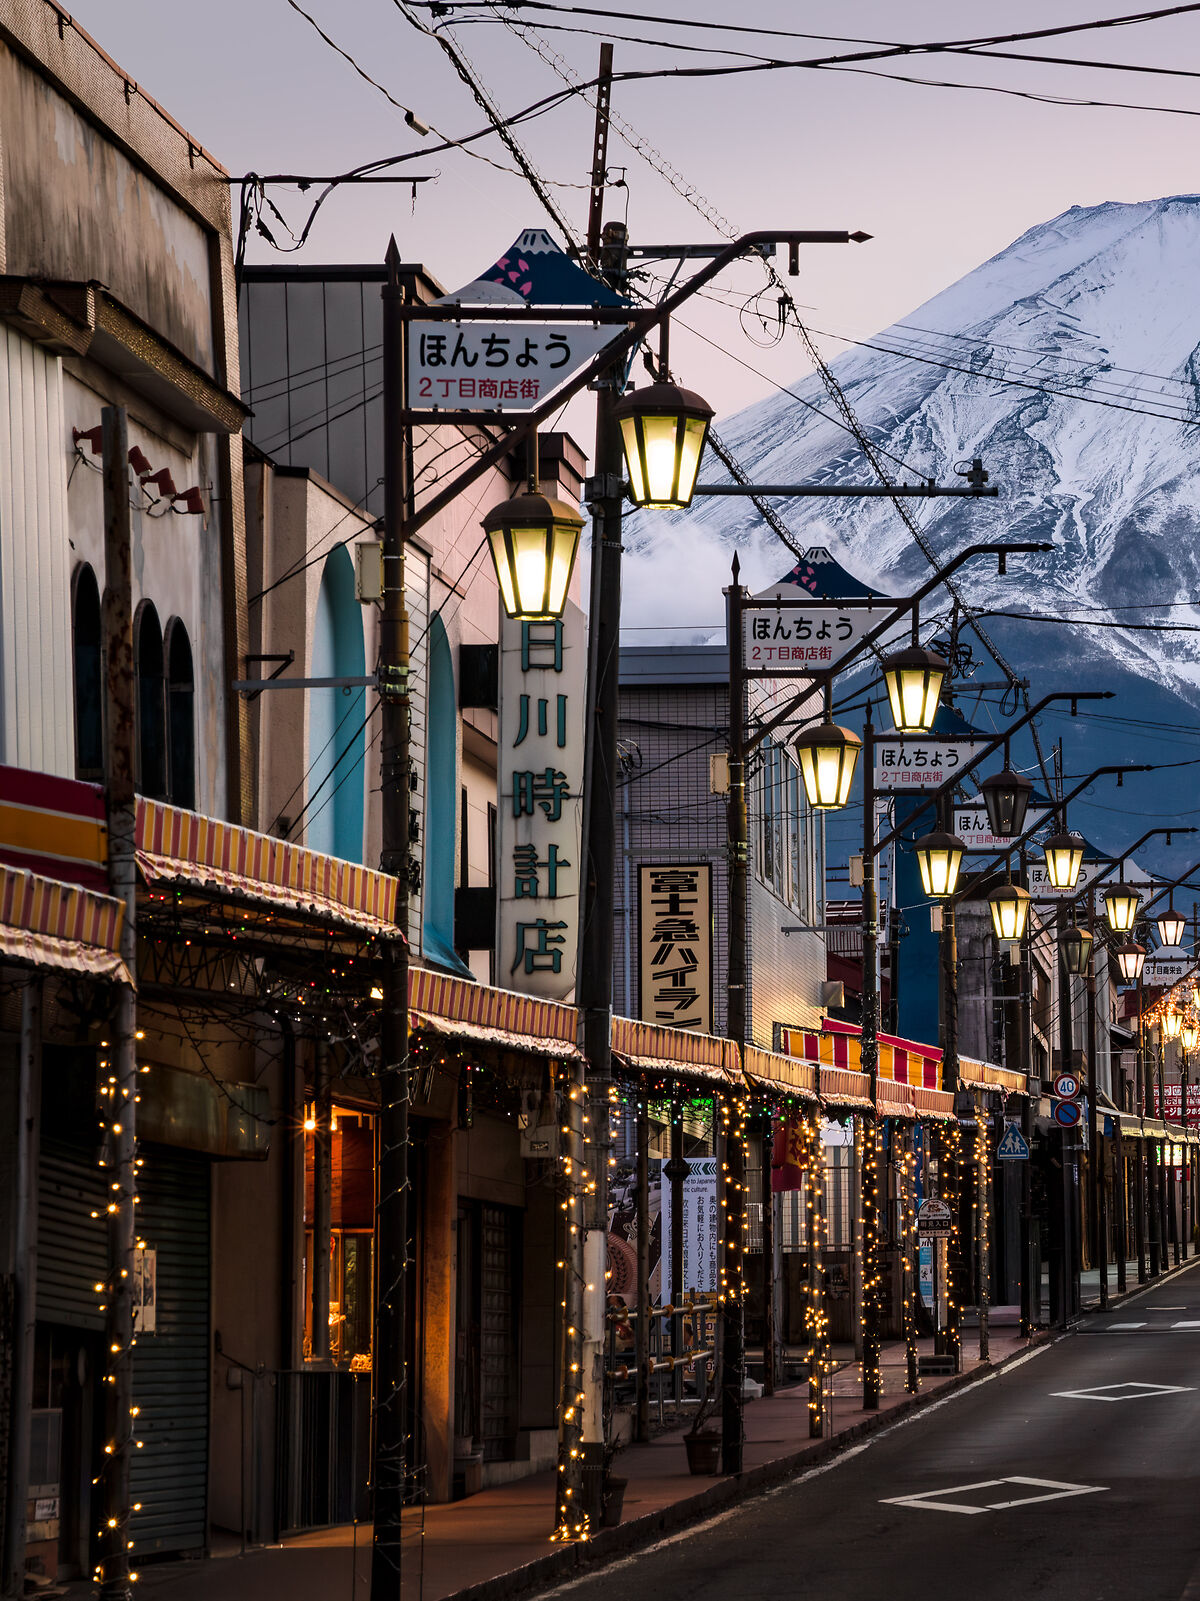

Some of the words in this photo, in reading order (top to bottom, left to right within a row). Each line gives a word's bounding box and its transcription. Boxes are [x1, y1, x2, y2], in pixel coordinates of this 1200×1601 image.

[419, 332, 571, 369] ほんちょう
[419, 377, 540, 399] 2丁目商店街
[752, 616, 853, 641] ほんちょう
[752, 646, 832, 661] 2丁目商店街
[881, 748, 960, 768] ほんちょう
[881, 770, 943, 783] 2丁目商店街
[1060, 1080, 1074, 1092] 40
